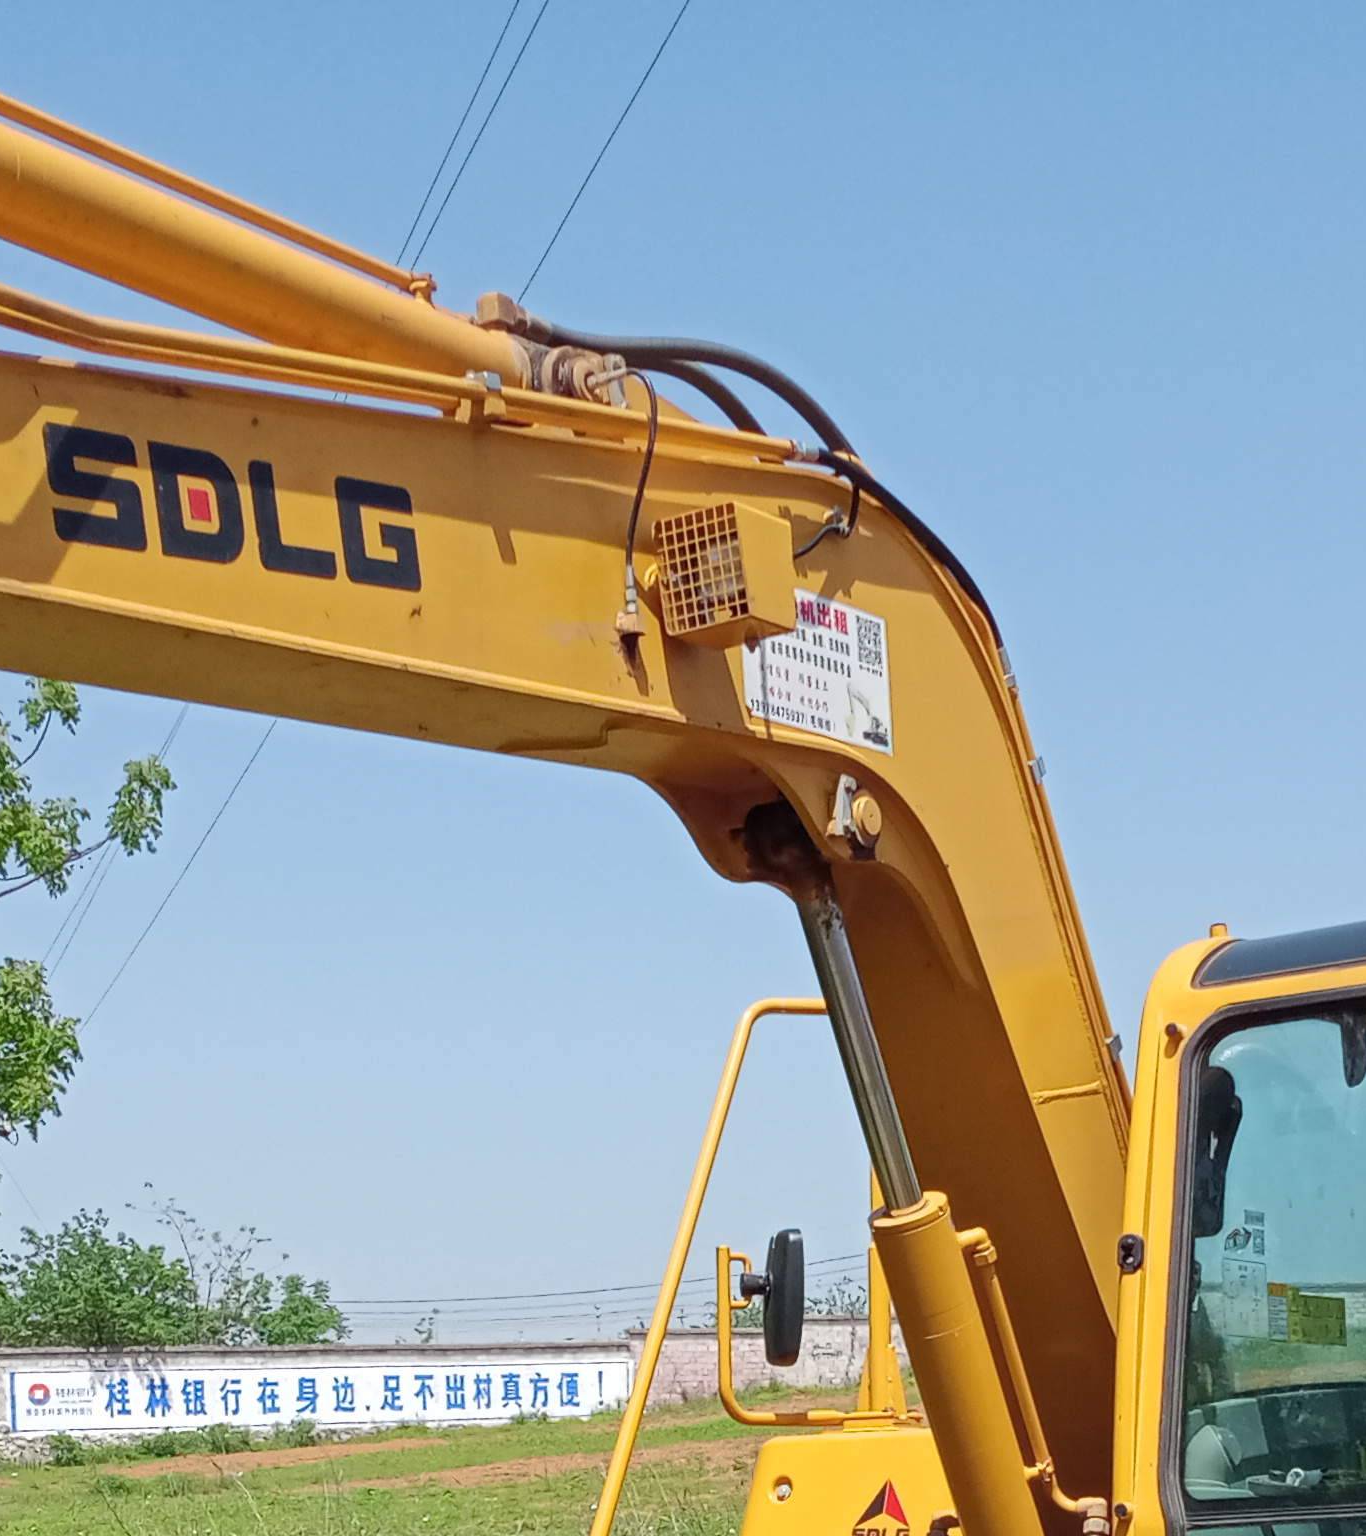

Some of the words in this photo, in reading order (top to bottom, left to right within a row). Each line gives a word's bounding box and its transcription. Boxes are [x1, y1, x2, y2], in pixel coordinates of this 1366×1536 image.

[44, 422, 422, 592] SDLG
[795, 598, 849, 636] 机出租
